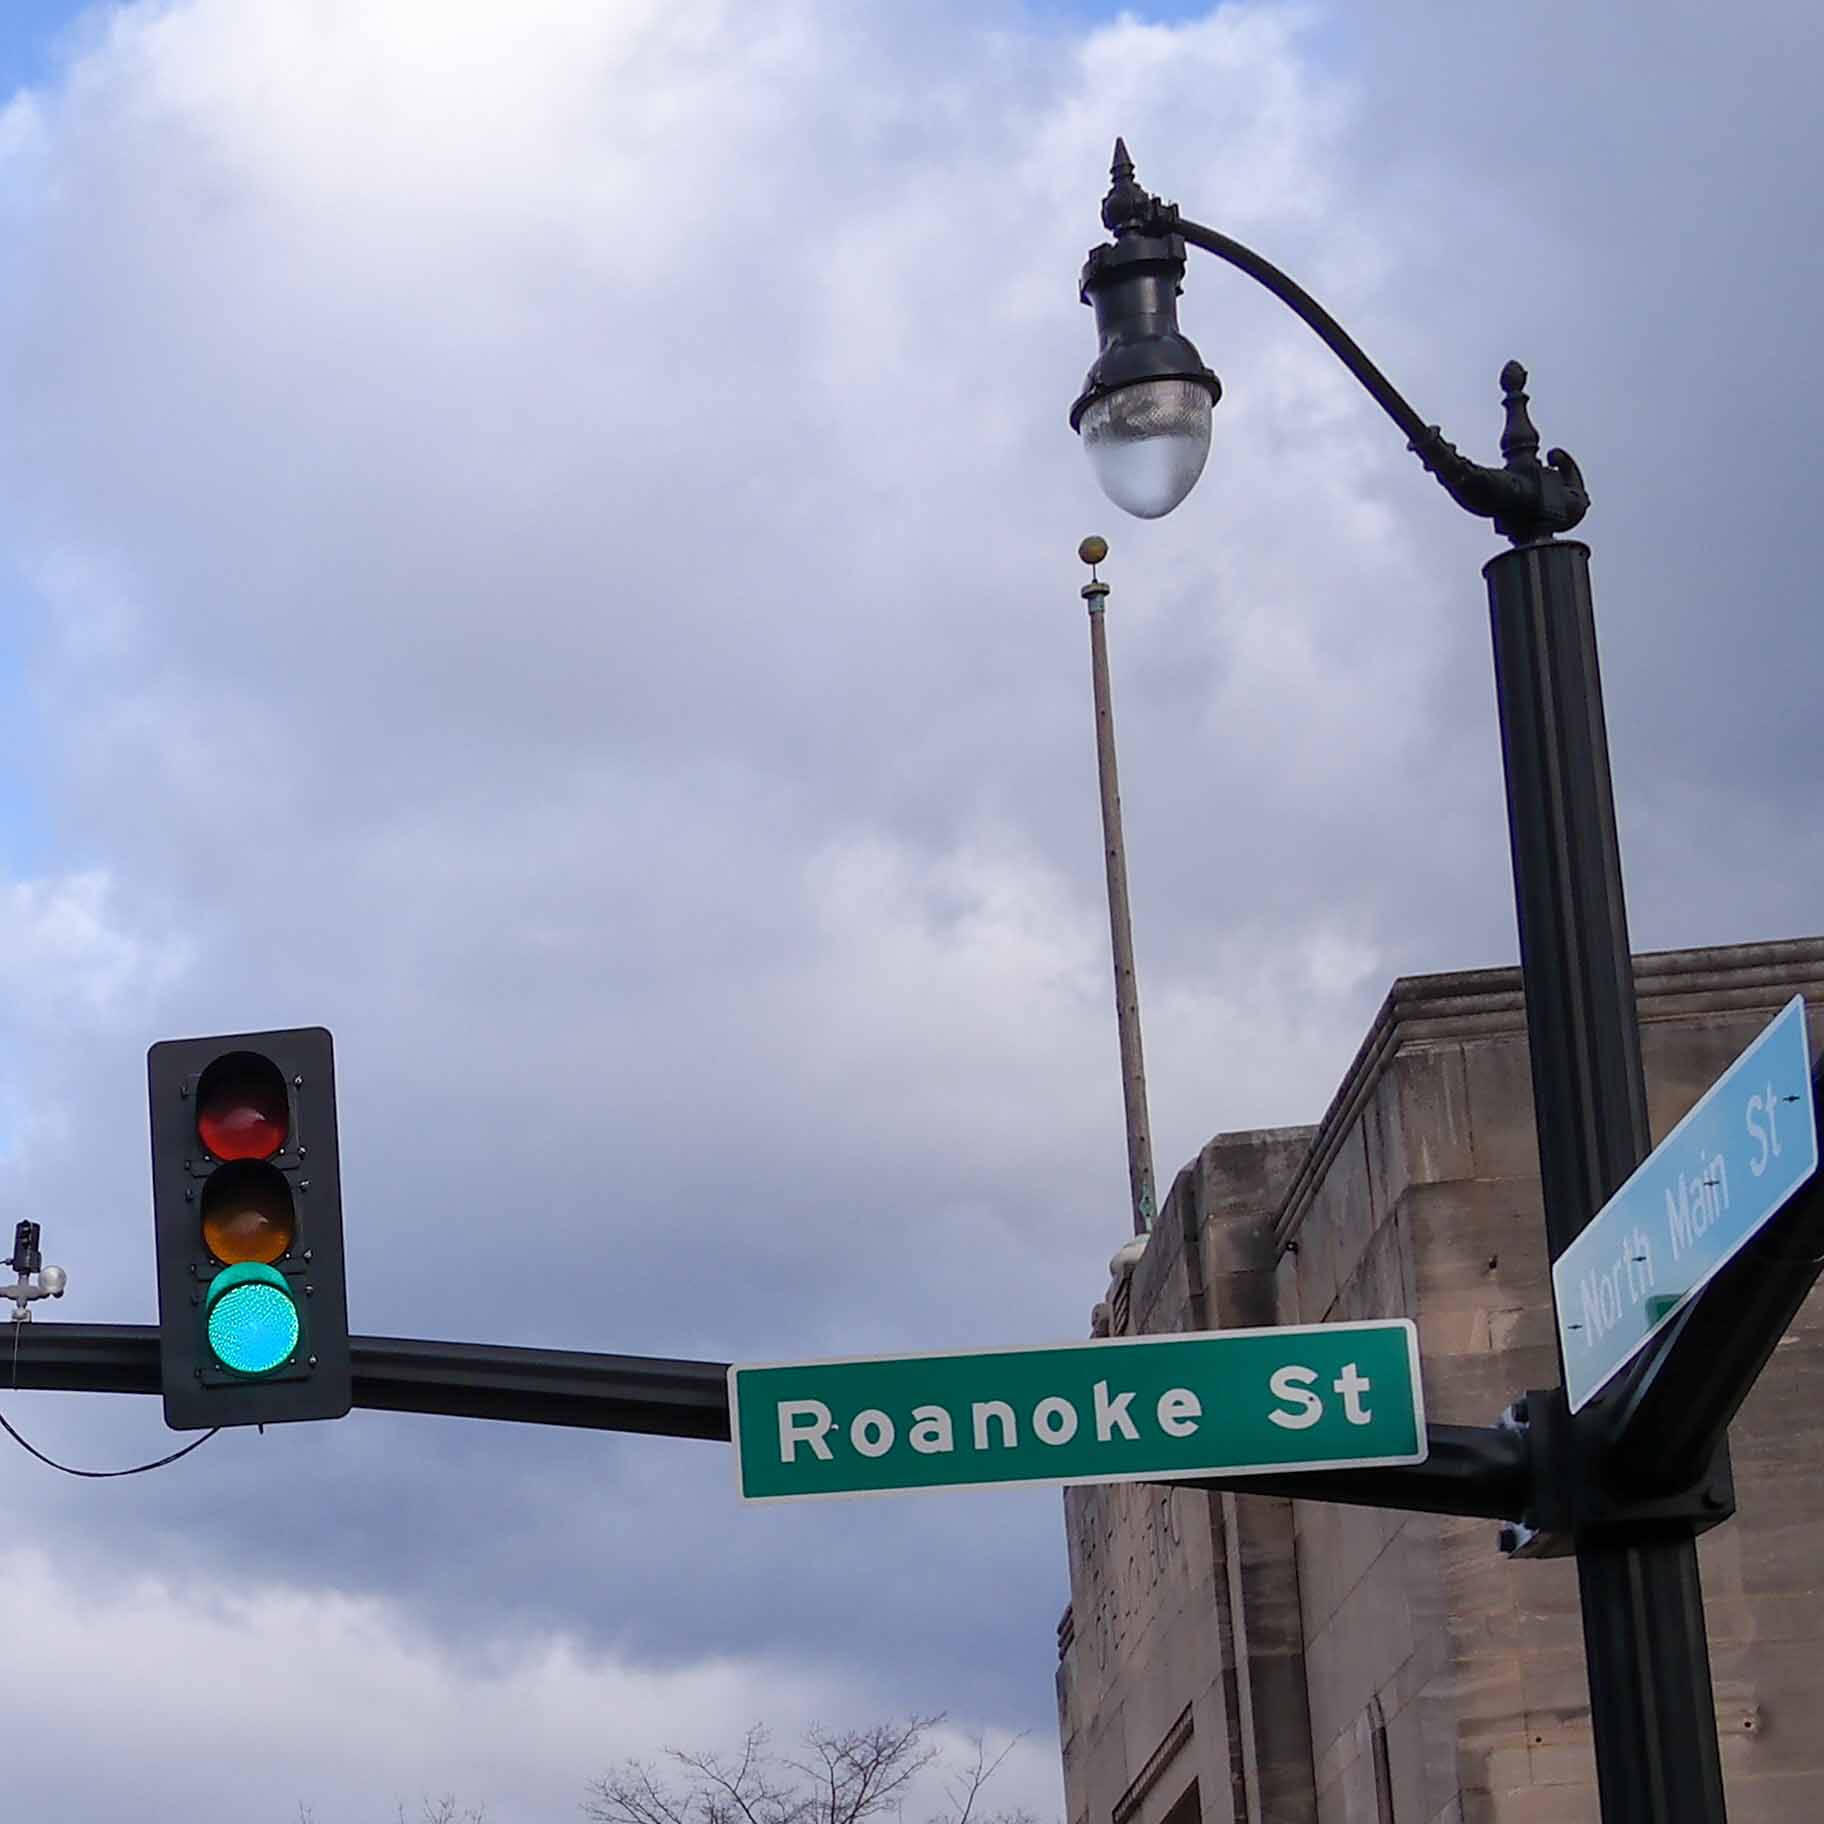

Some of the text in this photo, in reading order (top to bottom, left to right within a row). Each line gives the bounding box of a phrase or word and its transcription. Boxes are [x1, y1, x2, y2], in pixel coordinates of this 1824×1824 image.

[1579, 1079, 1783, 1348] North Main St
[777, 1362, 1373, 1463] Roanoke St
